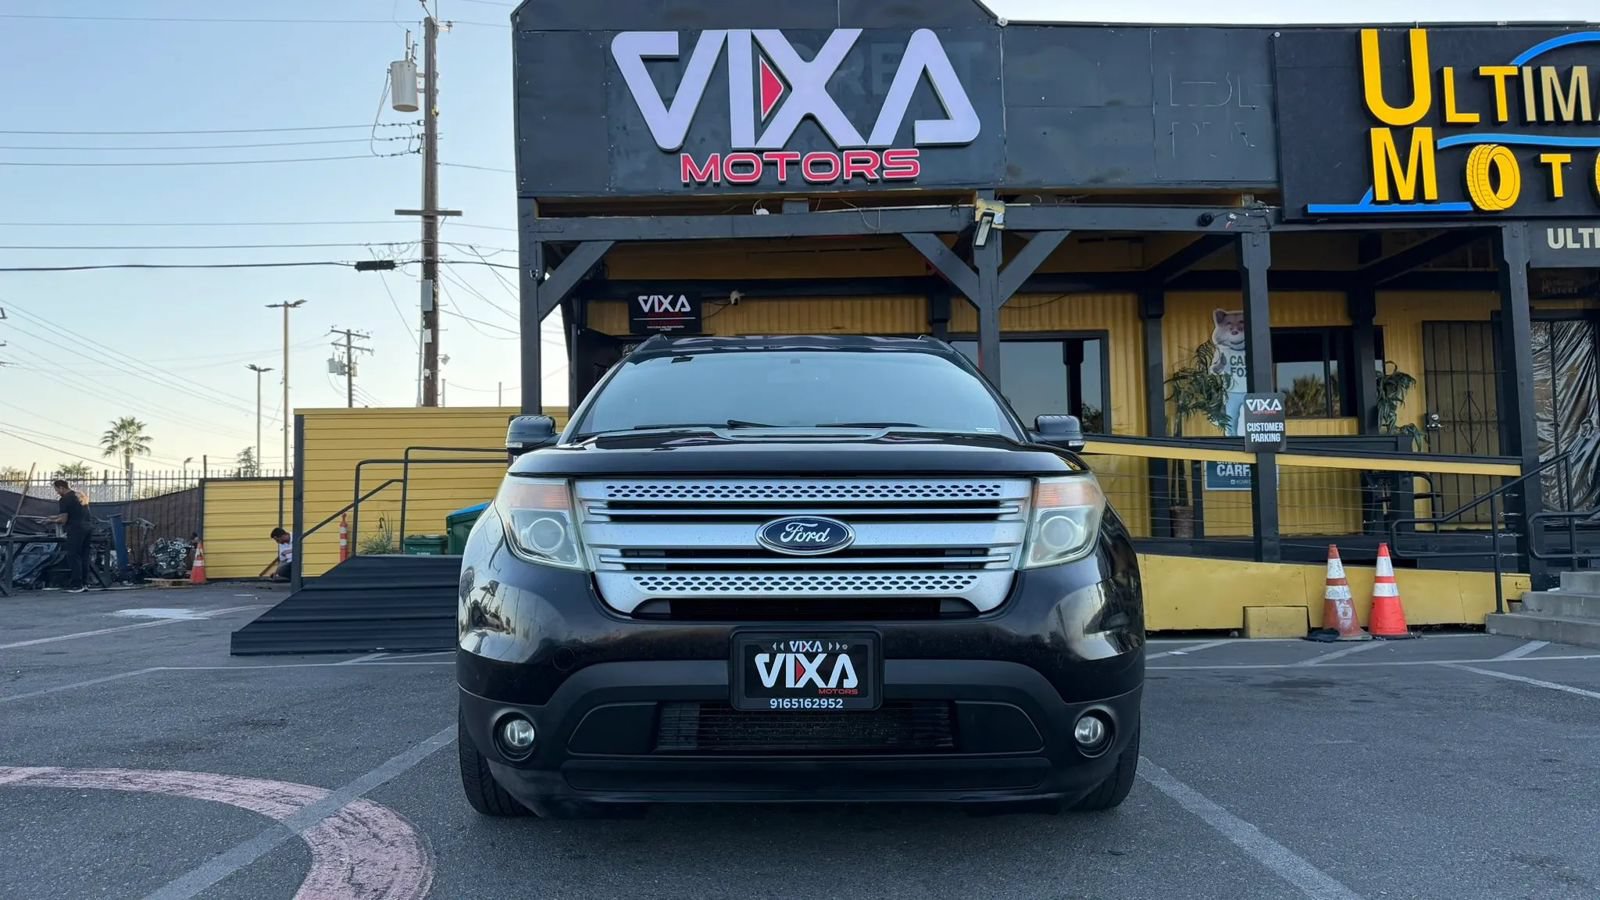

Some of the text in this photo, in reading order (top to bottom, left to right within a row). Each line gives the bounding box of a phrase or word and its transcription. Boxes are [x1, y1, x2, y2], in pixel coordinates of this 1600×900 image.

[1360, 28, 1600, 126] ULTIM
[611, 28, 981, 150] VIXA
[680, 149, 922, 183] MOTORS
[1370, 127, 1600, 211] MOT
[638, 294, 691, 313] VIXA
[1230, 355, 1246, 366] CA
[1245, 398, 1282, 411] VIXA
[1246, 422, 1284, 432] CUSTOMER
[1251, 433, 1281, 443] PARKING
[1216, 464, 1251, 477] CARF
[780, 522, 830, 543] Ford
[789, 640, 823, 652] VIXA
[754, 653, 859, 689] VIXA
[769, 698, 844, 709] 9165162952
